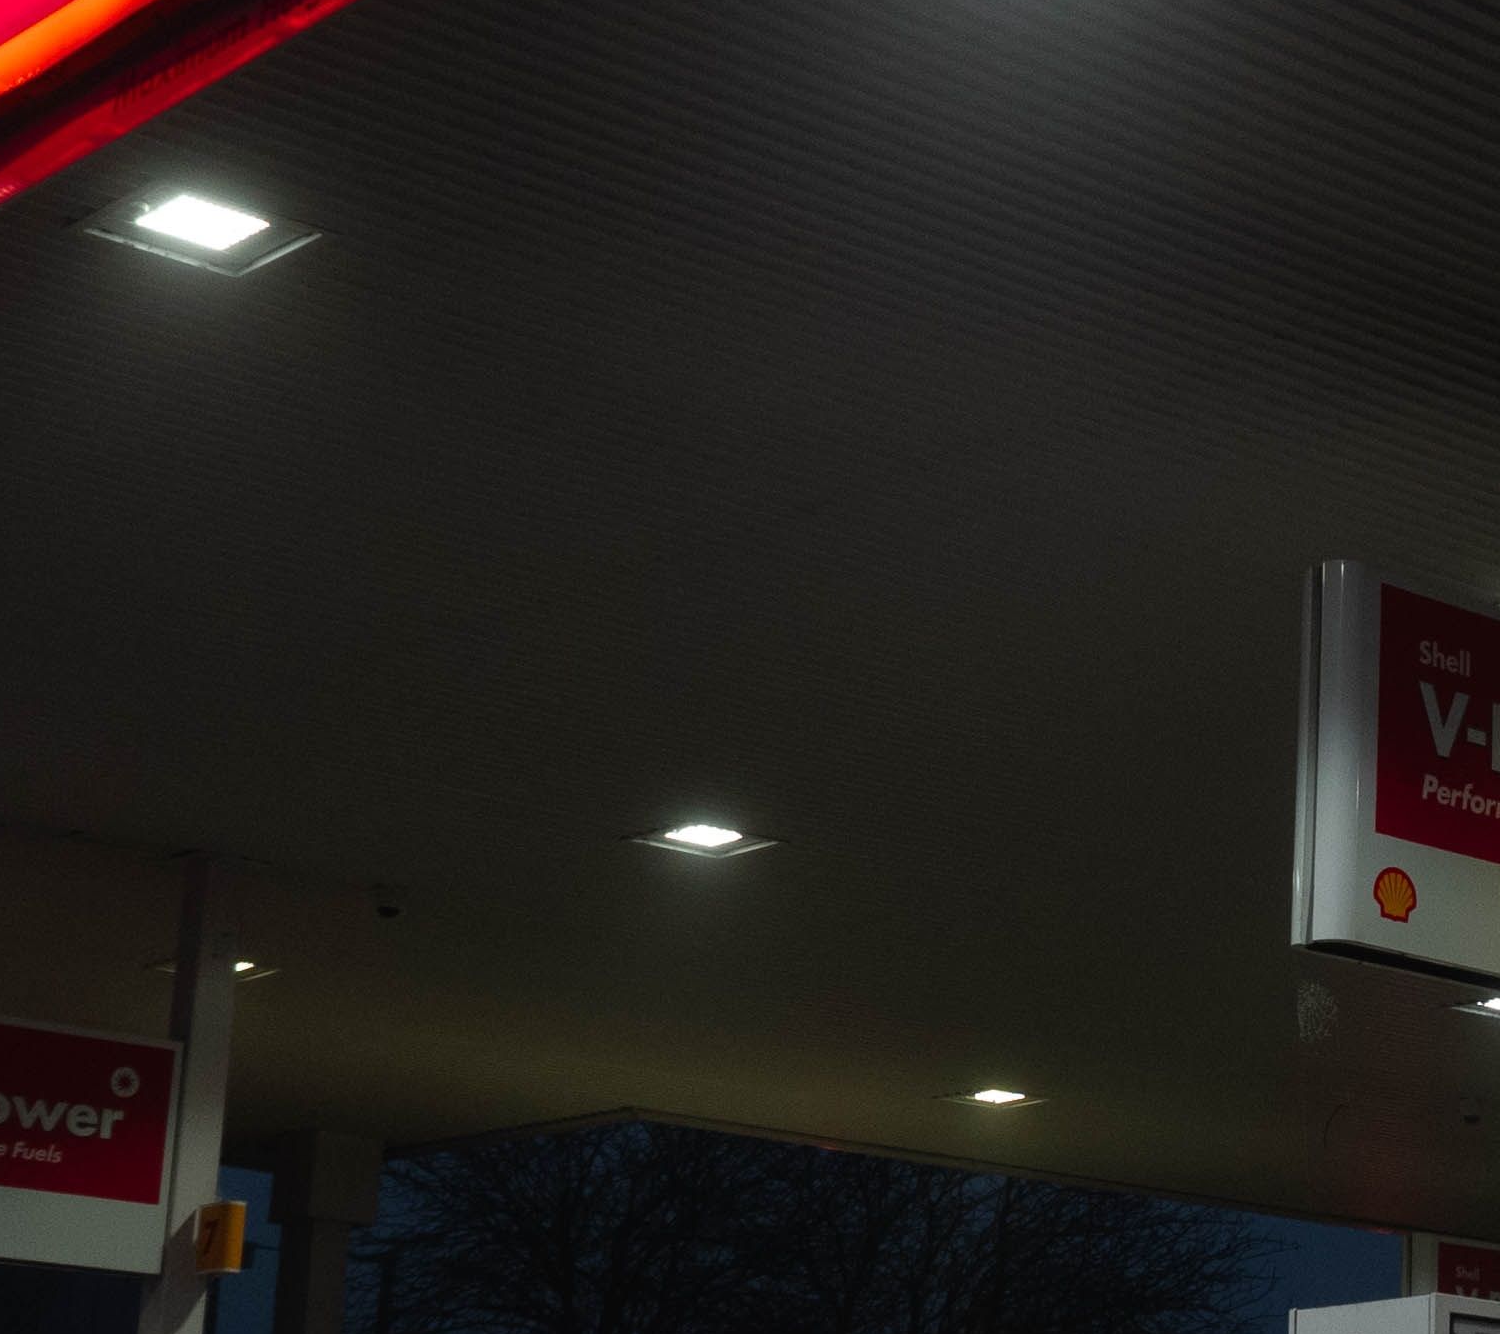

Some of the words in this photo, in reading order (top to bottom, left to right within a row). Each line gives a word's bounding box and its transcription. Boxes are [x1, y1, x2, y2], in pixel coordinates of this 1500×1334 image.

[1418, 640, 1472, 677] Shell
[12, 1141, 64, 1164] Fuels
[203, 1219, 219, 1255] 7
[1454, 1266, 1480, 1282] Shell
